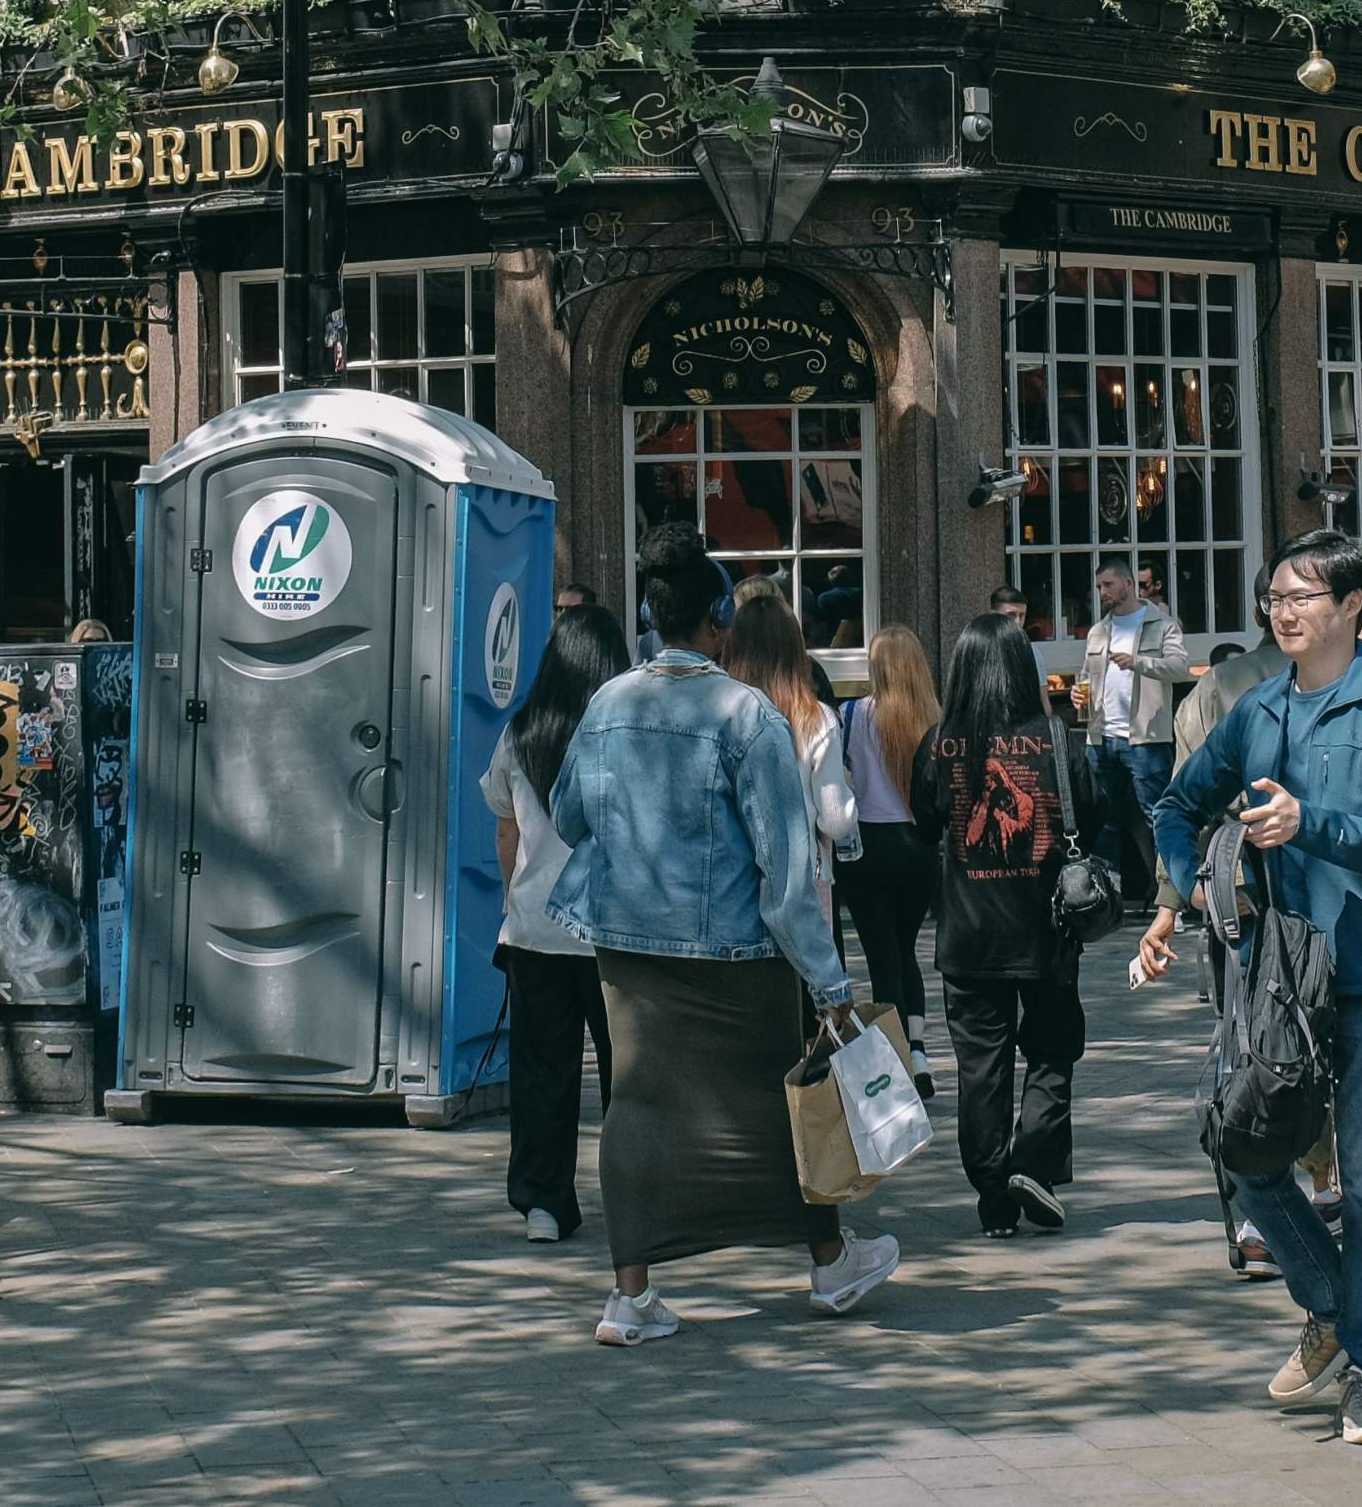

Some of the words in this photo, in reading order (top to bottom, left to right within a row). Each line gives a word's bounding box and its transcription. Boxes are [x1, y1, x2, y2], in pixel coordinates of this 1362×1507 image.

[1209, 109, 1317, 176] THE
[582, 210, 625, 238] 93
[872, 206, 916, 233] 93
[1109, 207, 1142, 228] THE
[1144, 209, 1233, 233] CAMBRIDGE
[671, 315, 833, 348] NICHOLSON'S
[254, 576, 323, 592] NIXON
[492, 665, 513, 681] NIXON
